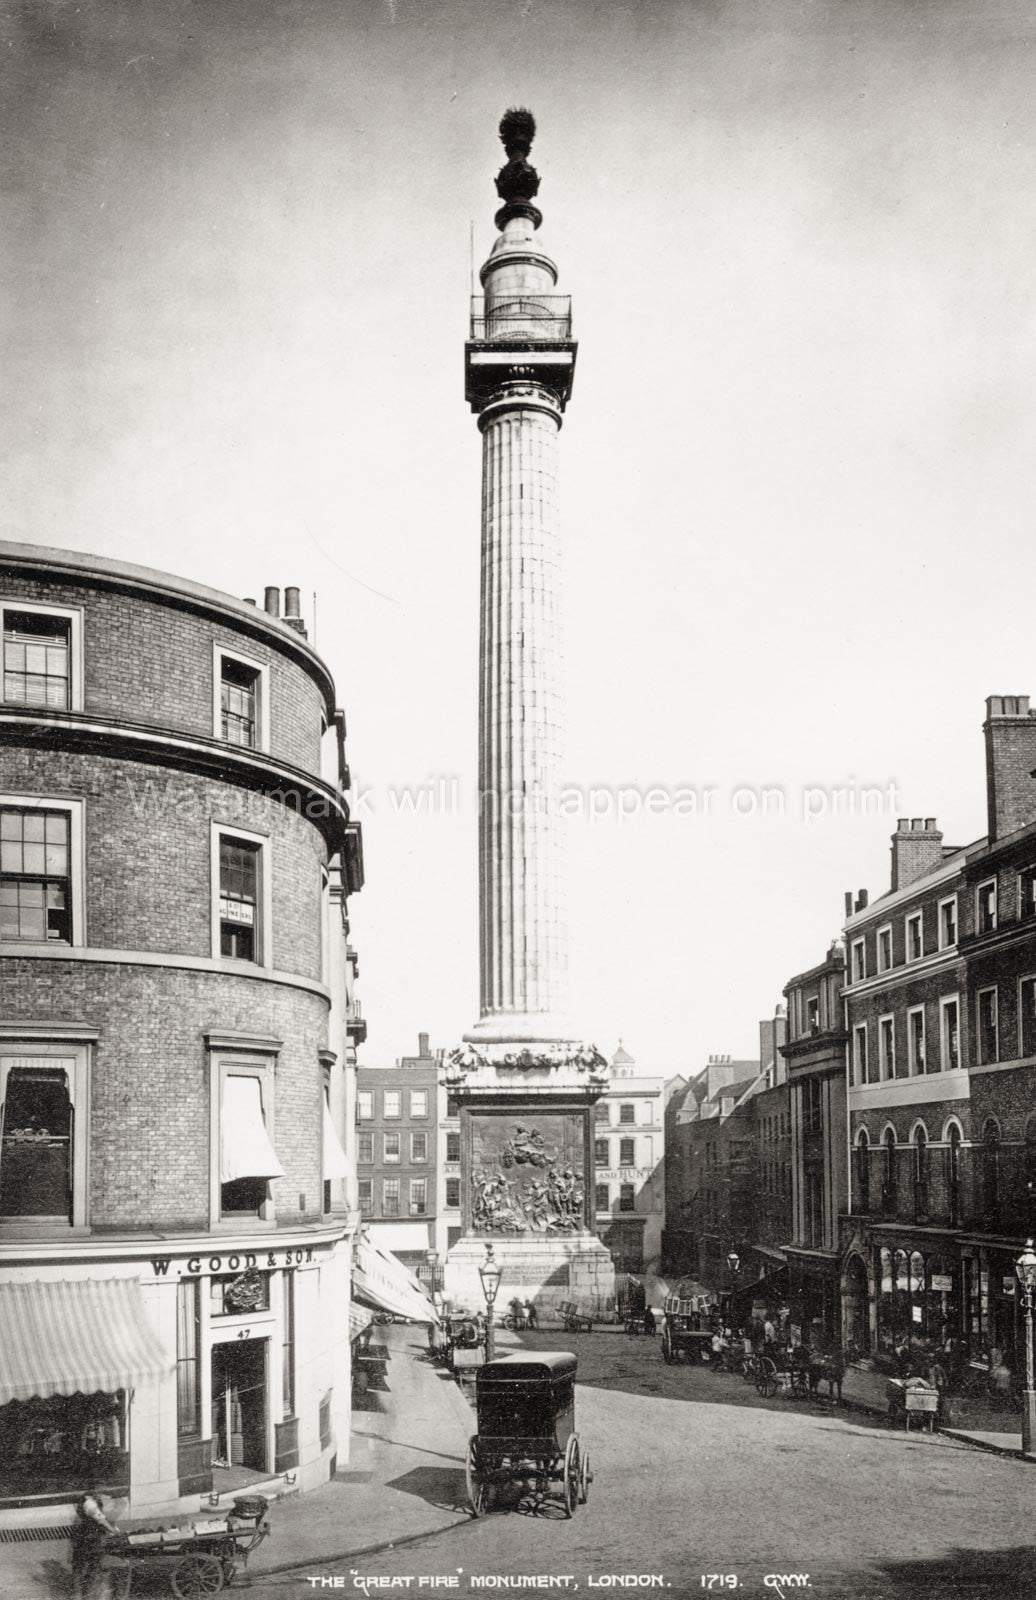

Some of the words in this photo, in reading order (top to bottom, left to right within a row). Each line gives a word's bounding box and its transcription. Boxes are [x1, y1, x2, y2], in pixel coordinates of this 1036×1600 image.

[187, 1253, 257, 1273] GOOD
[267, 1252, 277, 1267] &
[237, 1329, 251, 1339] 47
